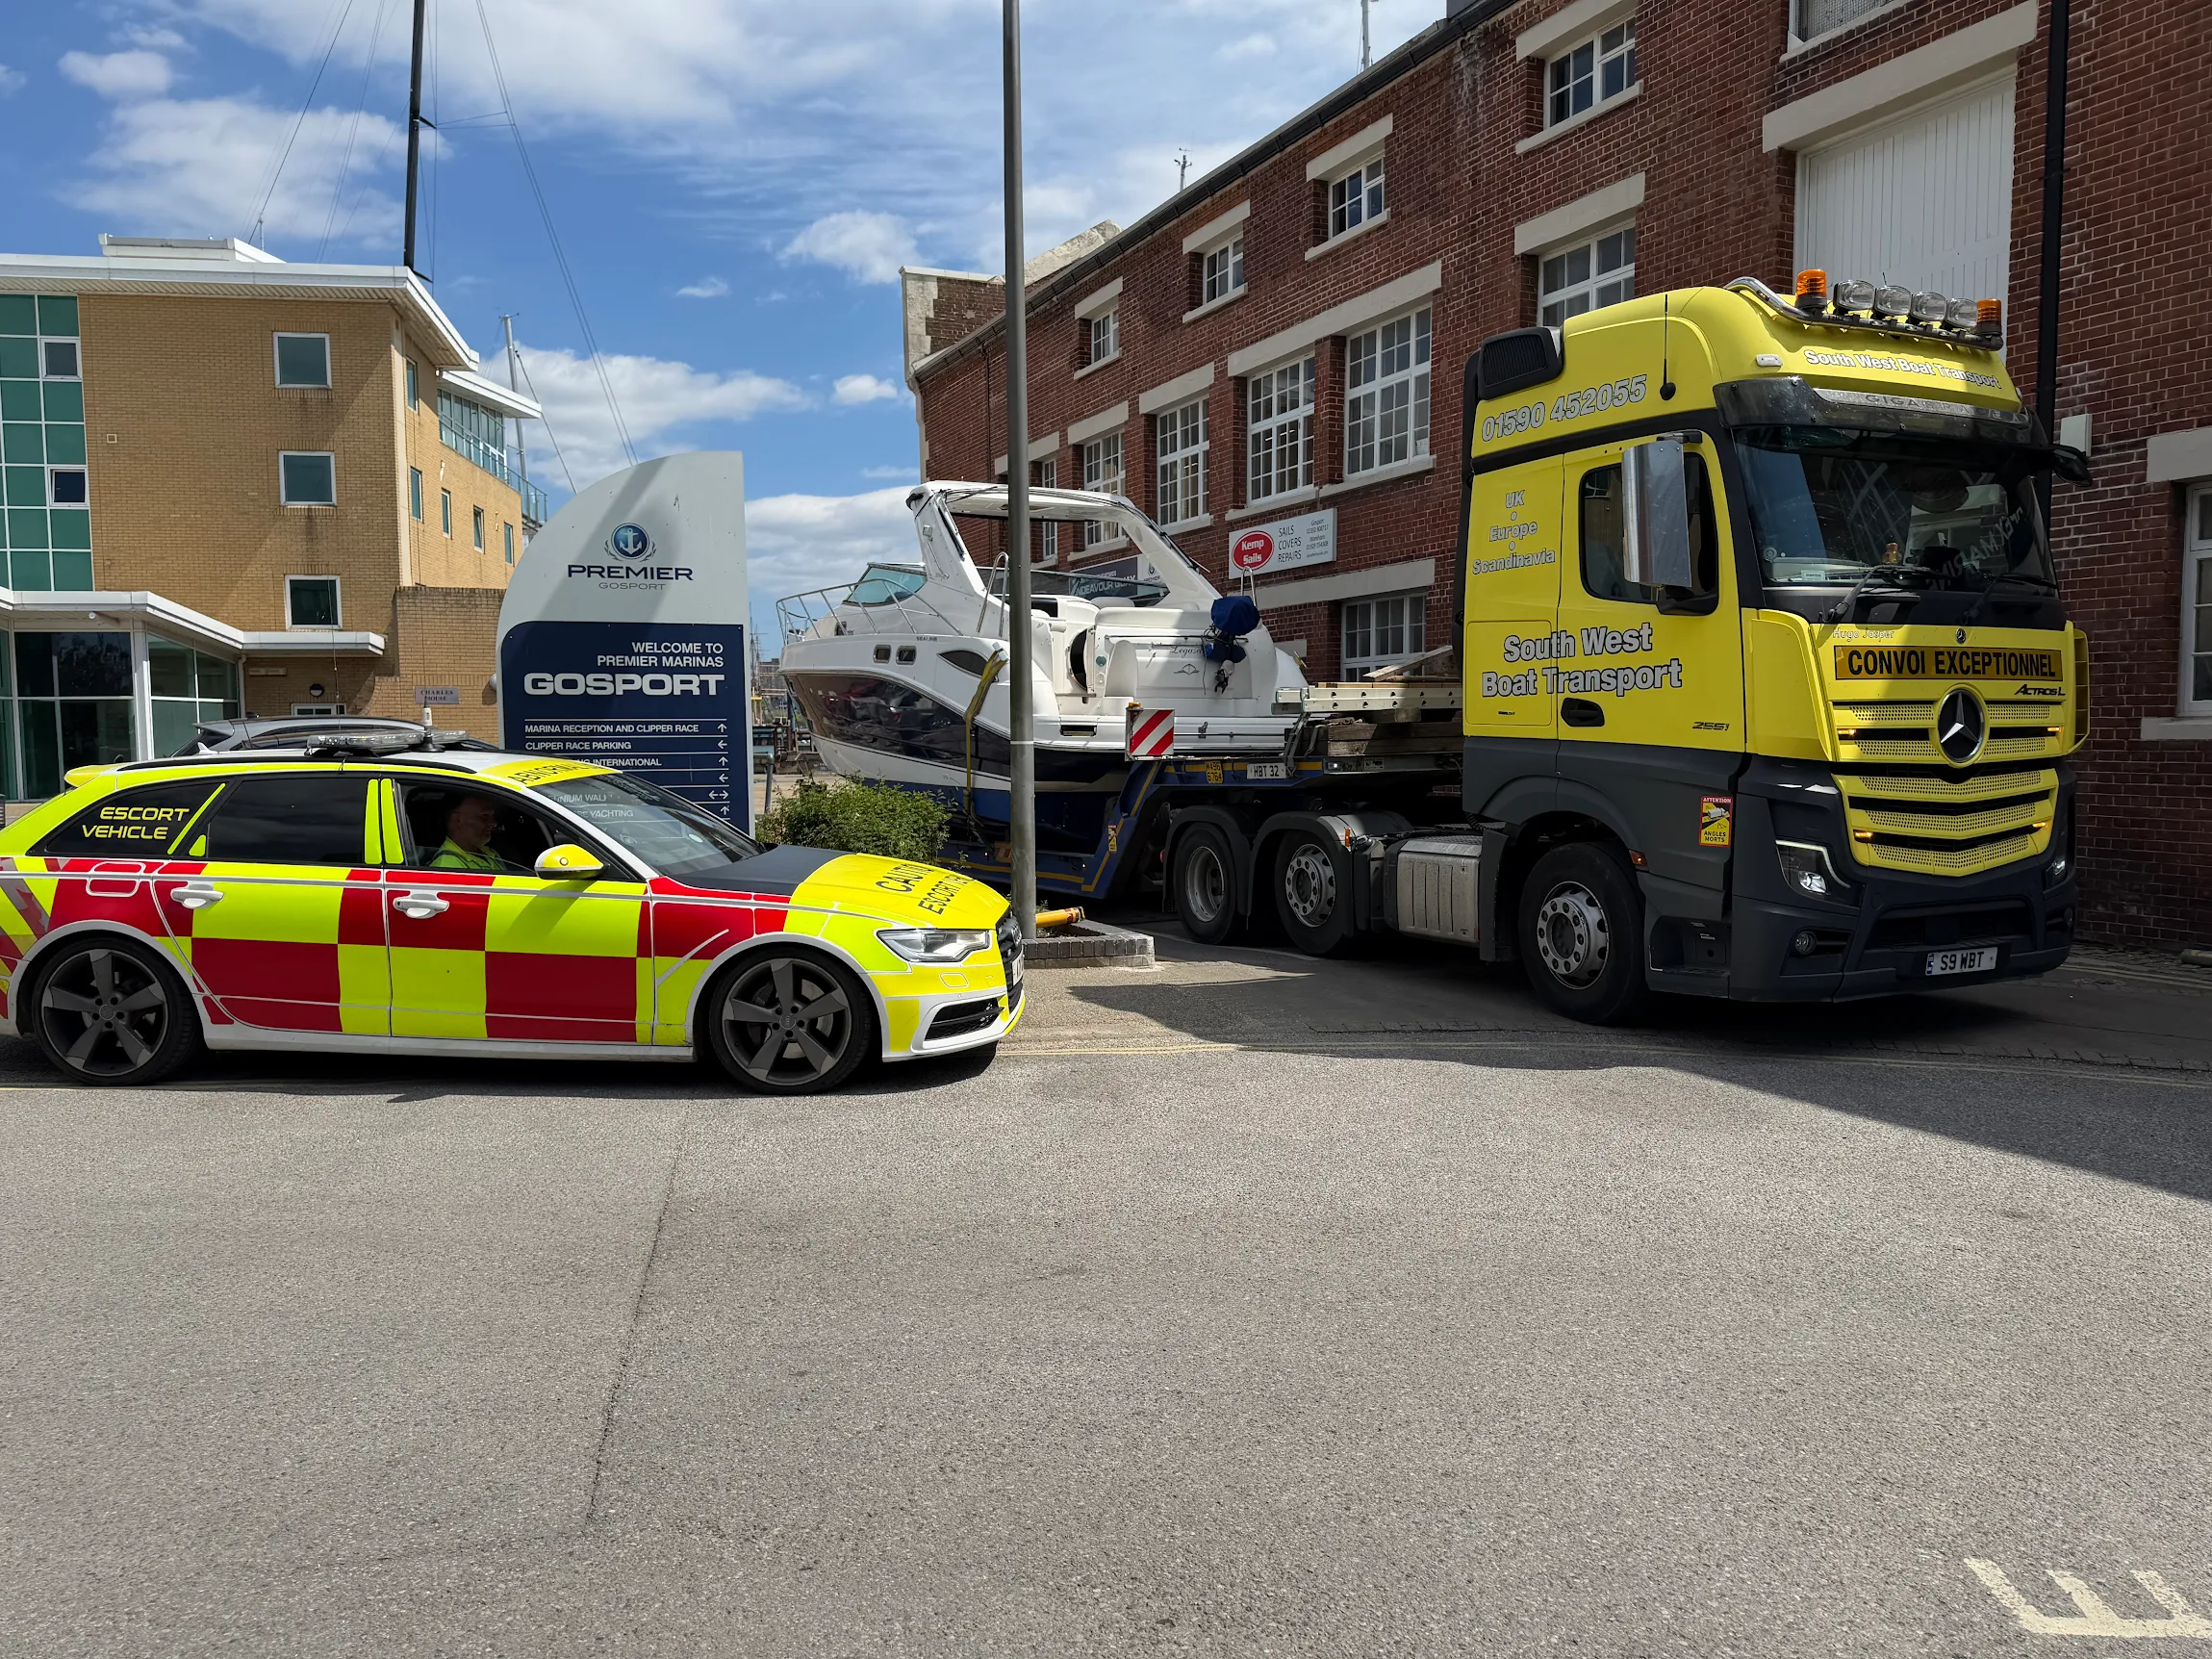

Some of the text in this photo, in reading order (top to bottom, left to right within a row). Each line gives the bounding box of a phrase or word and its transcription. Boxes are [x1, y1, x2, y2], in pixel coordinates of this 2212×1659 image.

[1804, 349, 2001, 389] South West Boat Transport
[1482, 374, 1647, 442] 01590 452055
[1506, 490, 1526, 509] UK
[1278, 525, 1294, 538] SAILS
[1488, 522, 1538, 542] Europe
[1241, 539, 1264, 551] Kemp
[1278, 537, 1302, 550] COVERS
[1242, 553, 1262, 565] Sails
[1278, 550, 1302, 563] REPAIRS
[1472, 548, 1556, 574] Scandinavia
[567, 564, 694, 581] PREMIER
[598, 581, 666, 591] GOSPORT
[1504, 622, 1653, 663] South West
[1833, 627, 1894, 643] Hugo Jasper
[631, 642, 724, 654] WELCOME TO
[597, 654, 725, 668] PREMIER MARINAS
[1847, 650, 2056, 677] CONVOI EXCEPTIONNEL
[523, 673, 725, 696] GOSPORT
[1482, 658, 1683, 698] Boat Transport
[524, 724, 699, 734] MARINA RECEPTION AND CLIPPER RACE
[525, 740, 631, 751] CLIPPER RACE PARKING
[592, 757, 662, 767] INTERNATIONAL
[1254, 765, 1280, 778] HBT 32
[99, 806, 190, 822] ESCORT
[590, 809, 634, 819] YACHTING
[82, 825, 168, 840] VEHICLE
[1940, 951, 1985, 971] S9 WBT
